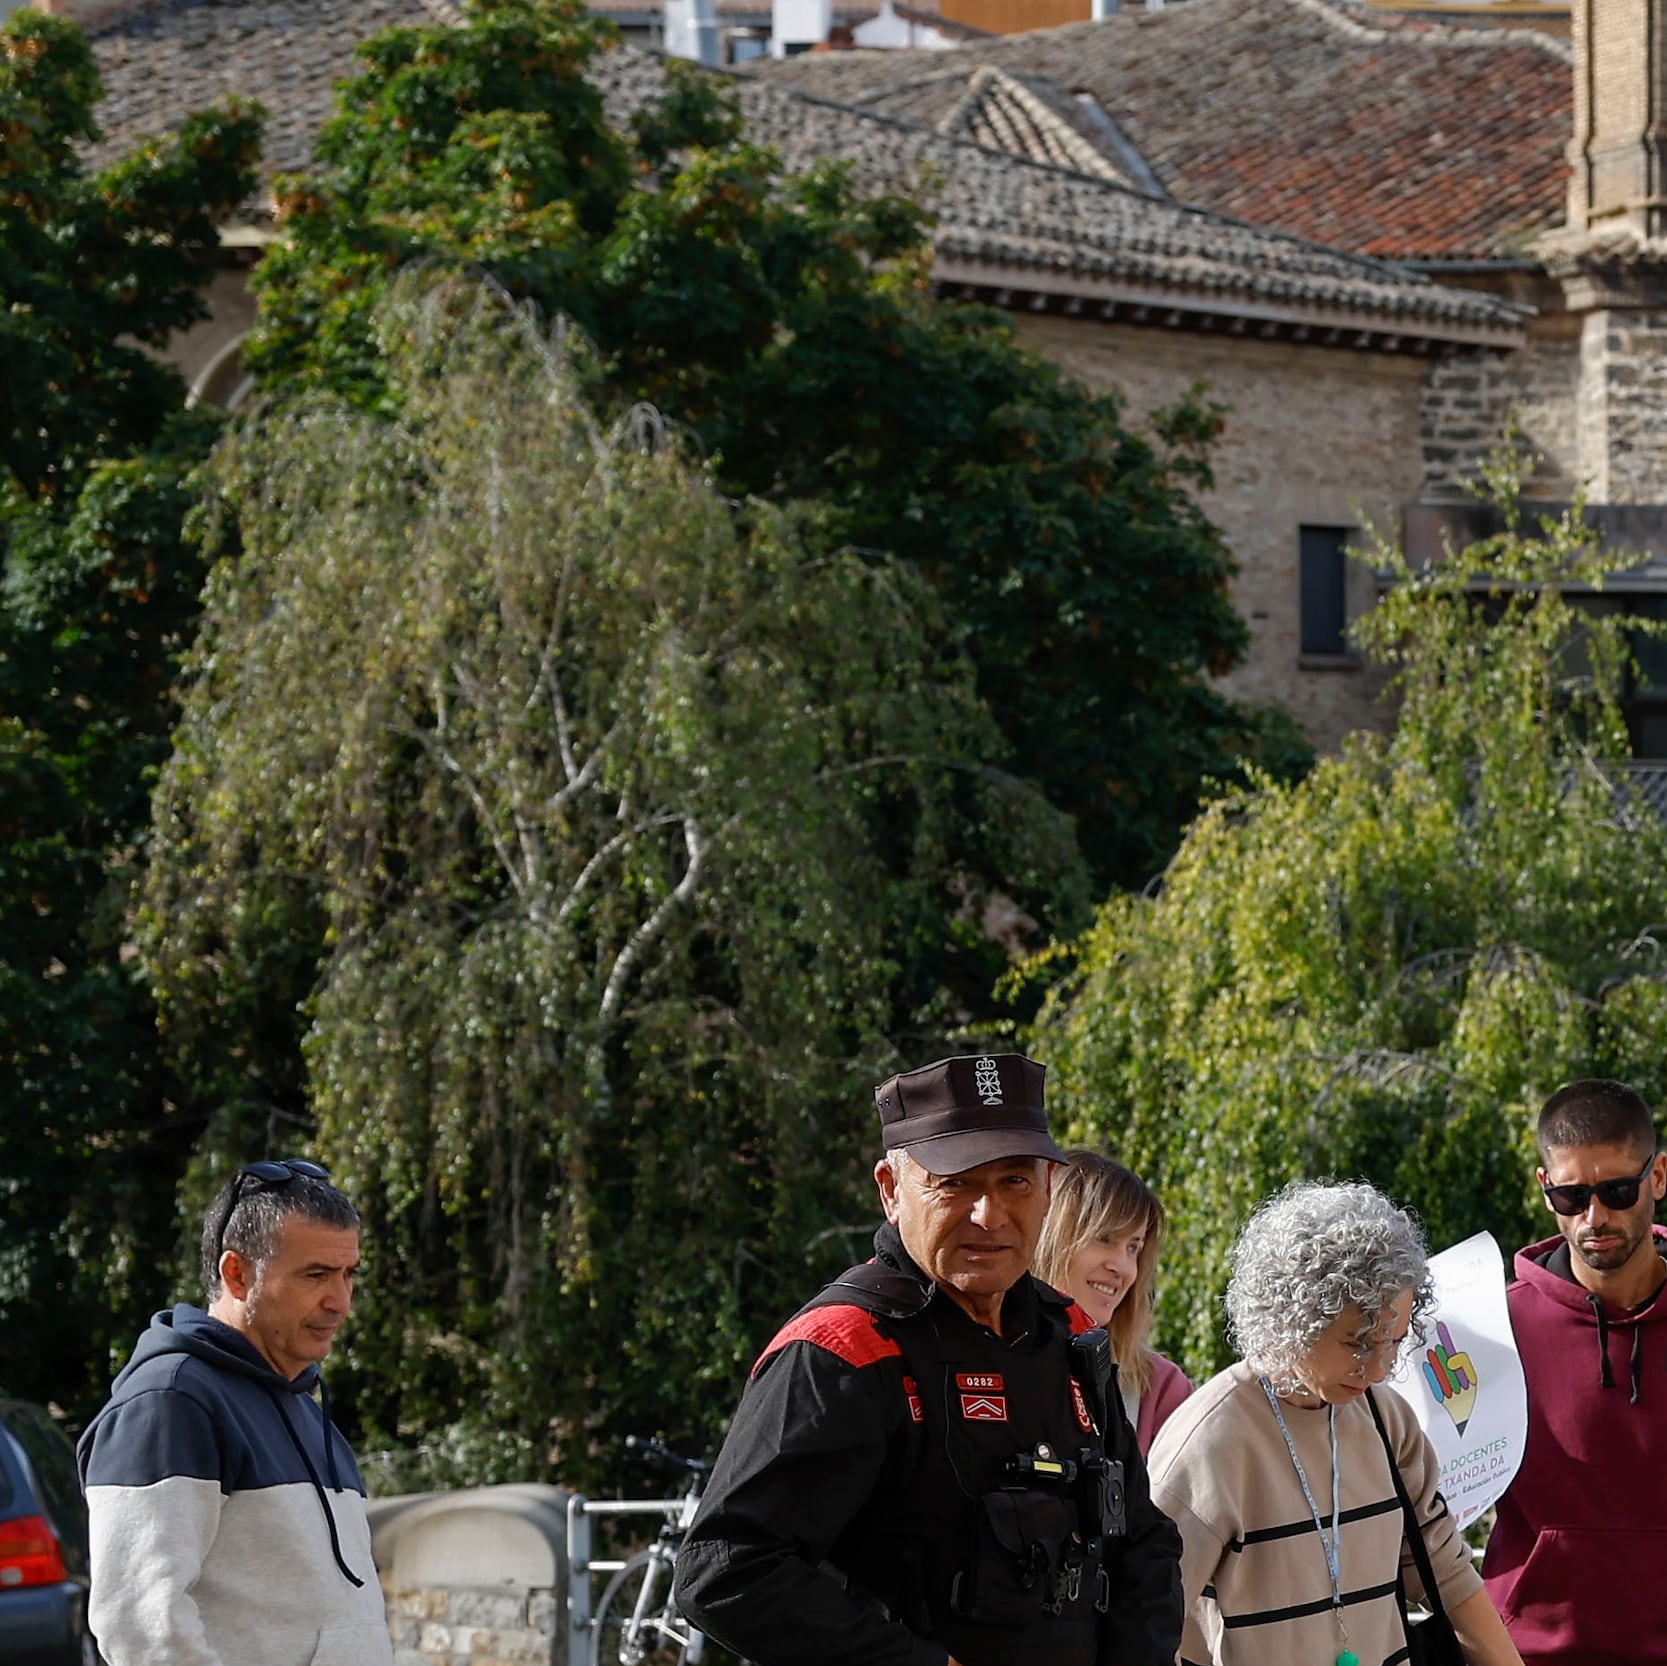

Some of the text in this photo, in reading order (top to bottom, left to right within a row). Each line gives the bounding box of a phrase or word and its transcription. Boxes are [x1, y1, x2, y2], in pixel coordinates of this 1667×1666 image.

[966, 1377, 995, 1387] 0282
[1451, 1437, 1508, 1472] DOCENTES
[1444, 1455, 1505, 1490] TXANDA DA
